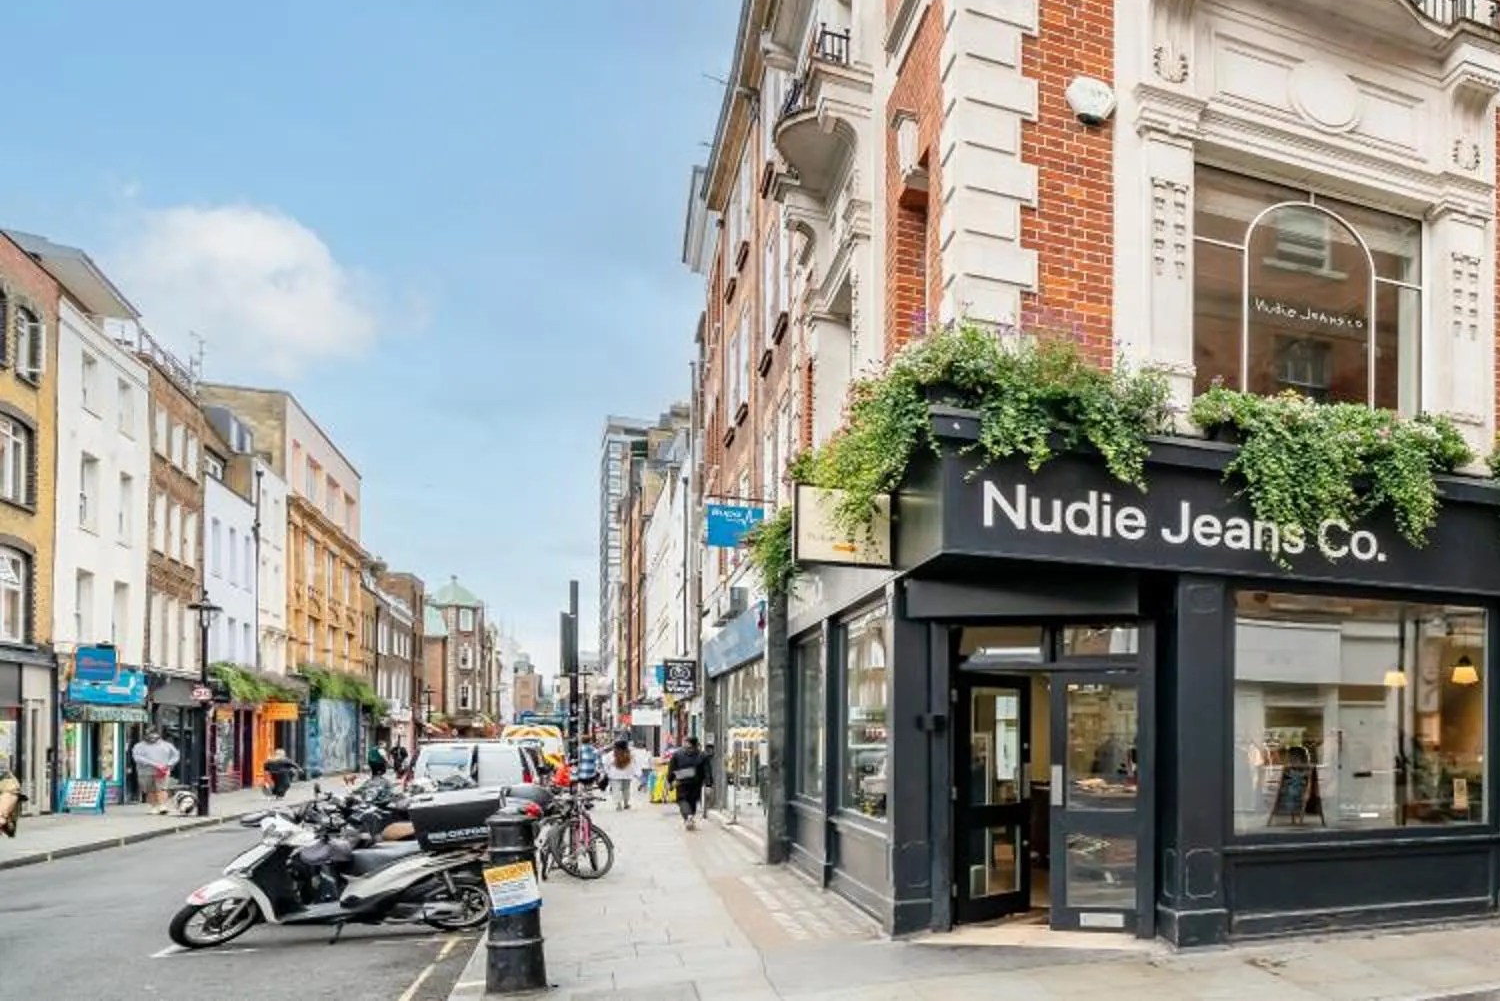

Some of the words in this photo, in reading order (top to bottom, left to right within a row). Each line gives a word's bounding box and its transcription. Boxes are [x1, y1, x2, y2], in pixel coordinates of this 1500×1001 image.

[982, 480, 1148, 541] Nudie
[1161, 500, 1306, 556] Jeans
[1316, 517, 1387, 563] Co.
